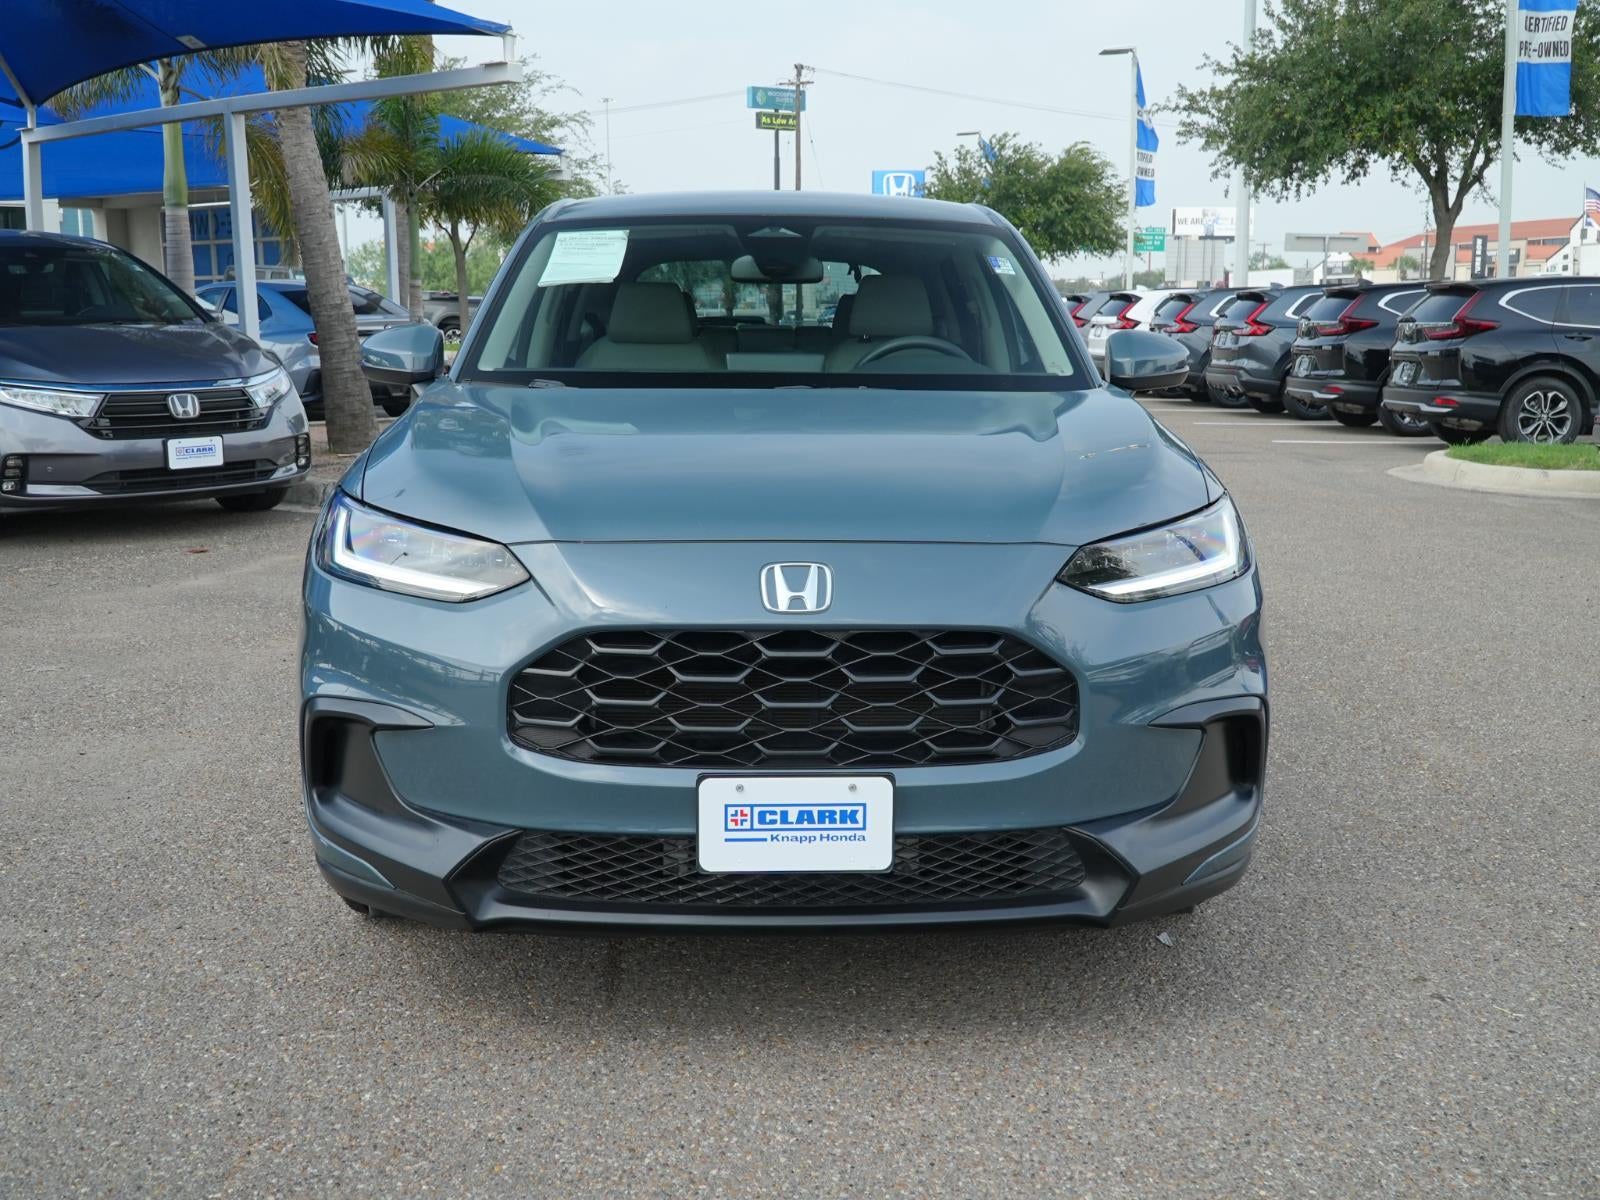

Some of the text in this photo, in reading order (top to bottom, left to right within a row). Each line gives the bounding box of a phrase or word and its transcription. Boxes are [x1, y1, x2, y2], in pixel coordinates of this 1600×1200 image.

[1519, 40, 1569, 58] PRE-OWNED
[773, 116, 787, 125] Low
[1177, 217, 1187, 225] WE
[185, 446, 214, 454] CLARK
[757, 809, 860, 825] CLARK
[770, 833, 866, 844] Knapp Honda
